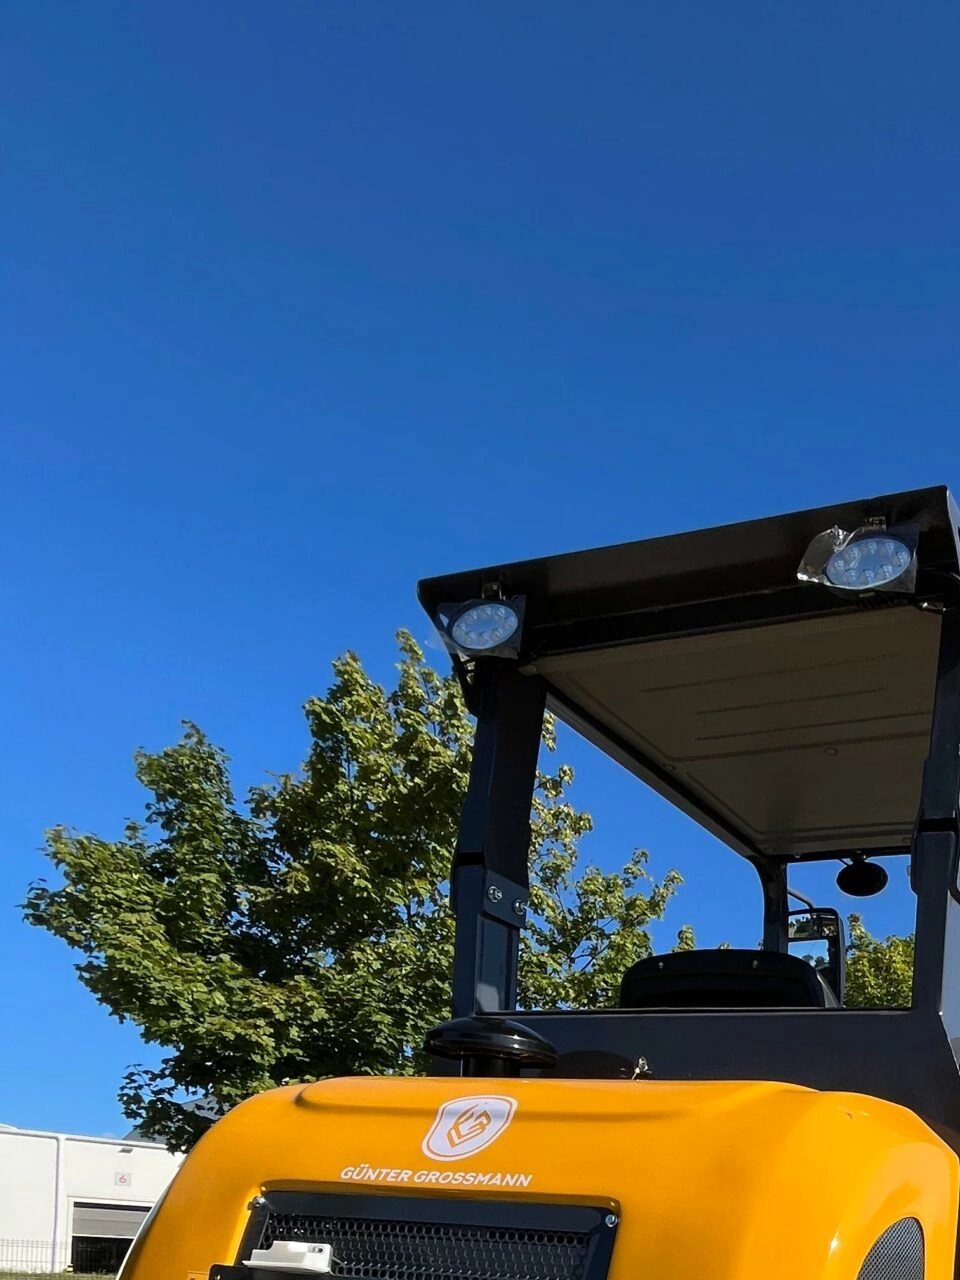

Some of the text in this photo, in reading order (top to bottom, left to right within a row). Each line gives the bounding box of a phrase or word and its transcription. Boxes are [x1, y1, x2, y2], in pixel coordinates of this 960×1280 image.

[118, 1174, 127, 1184] 6
[340, 1163, 532, 1187] GÜNTER GROSSMANN
